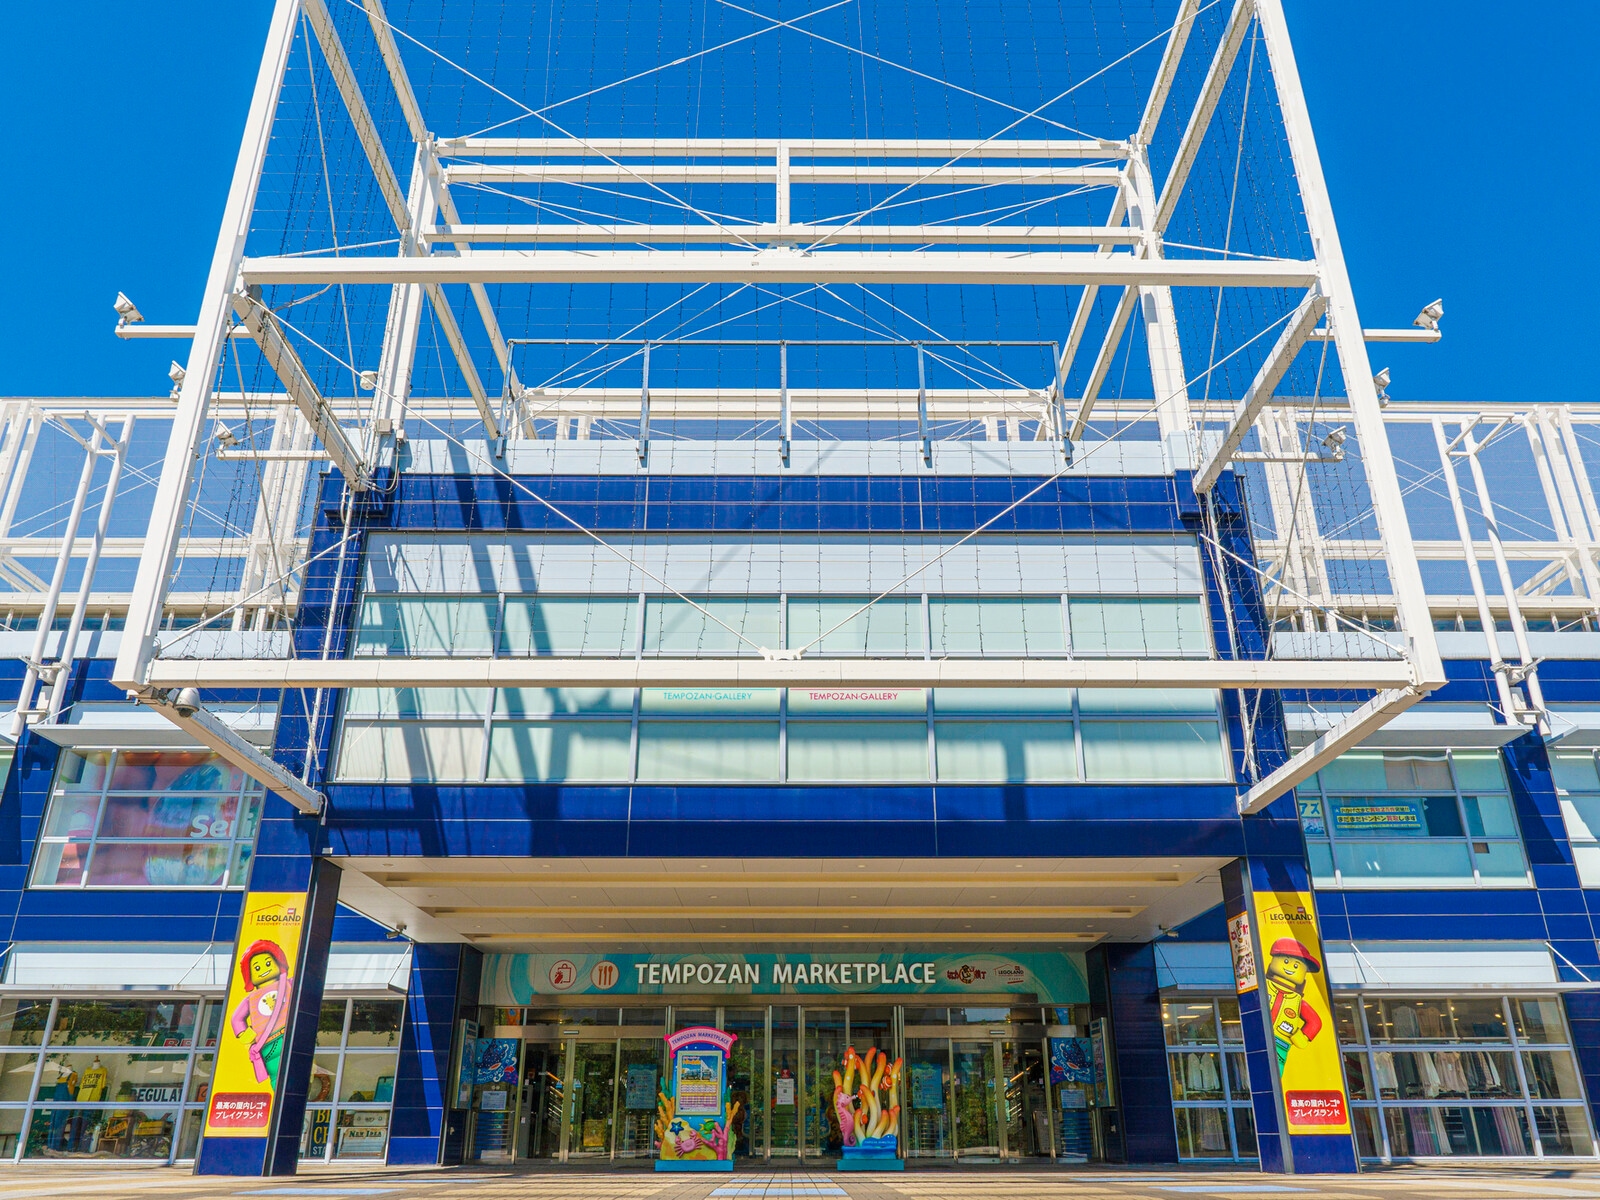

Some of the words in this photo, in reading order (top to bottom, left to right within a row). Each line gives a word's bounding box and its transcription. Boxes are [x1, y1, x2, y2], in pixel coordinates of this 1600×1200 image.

[257, 914, 301, 922] LEGOLAND
[1270, 913, 1313, 921] LEGOLAND
[634, 963, 760, 985] TEMPOZAN
[772, 963, 937, 985] MARKETPLACE
[671, 1032, 697, 1045] TEMPOZAN
[698, 1032, 729, 1045] MARKETPLACE
[215, 1111, 264, 1120] プレイグランド
[1293, 1109, 1340, 1117] プレイグランド
